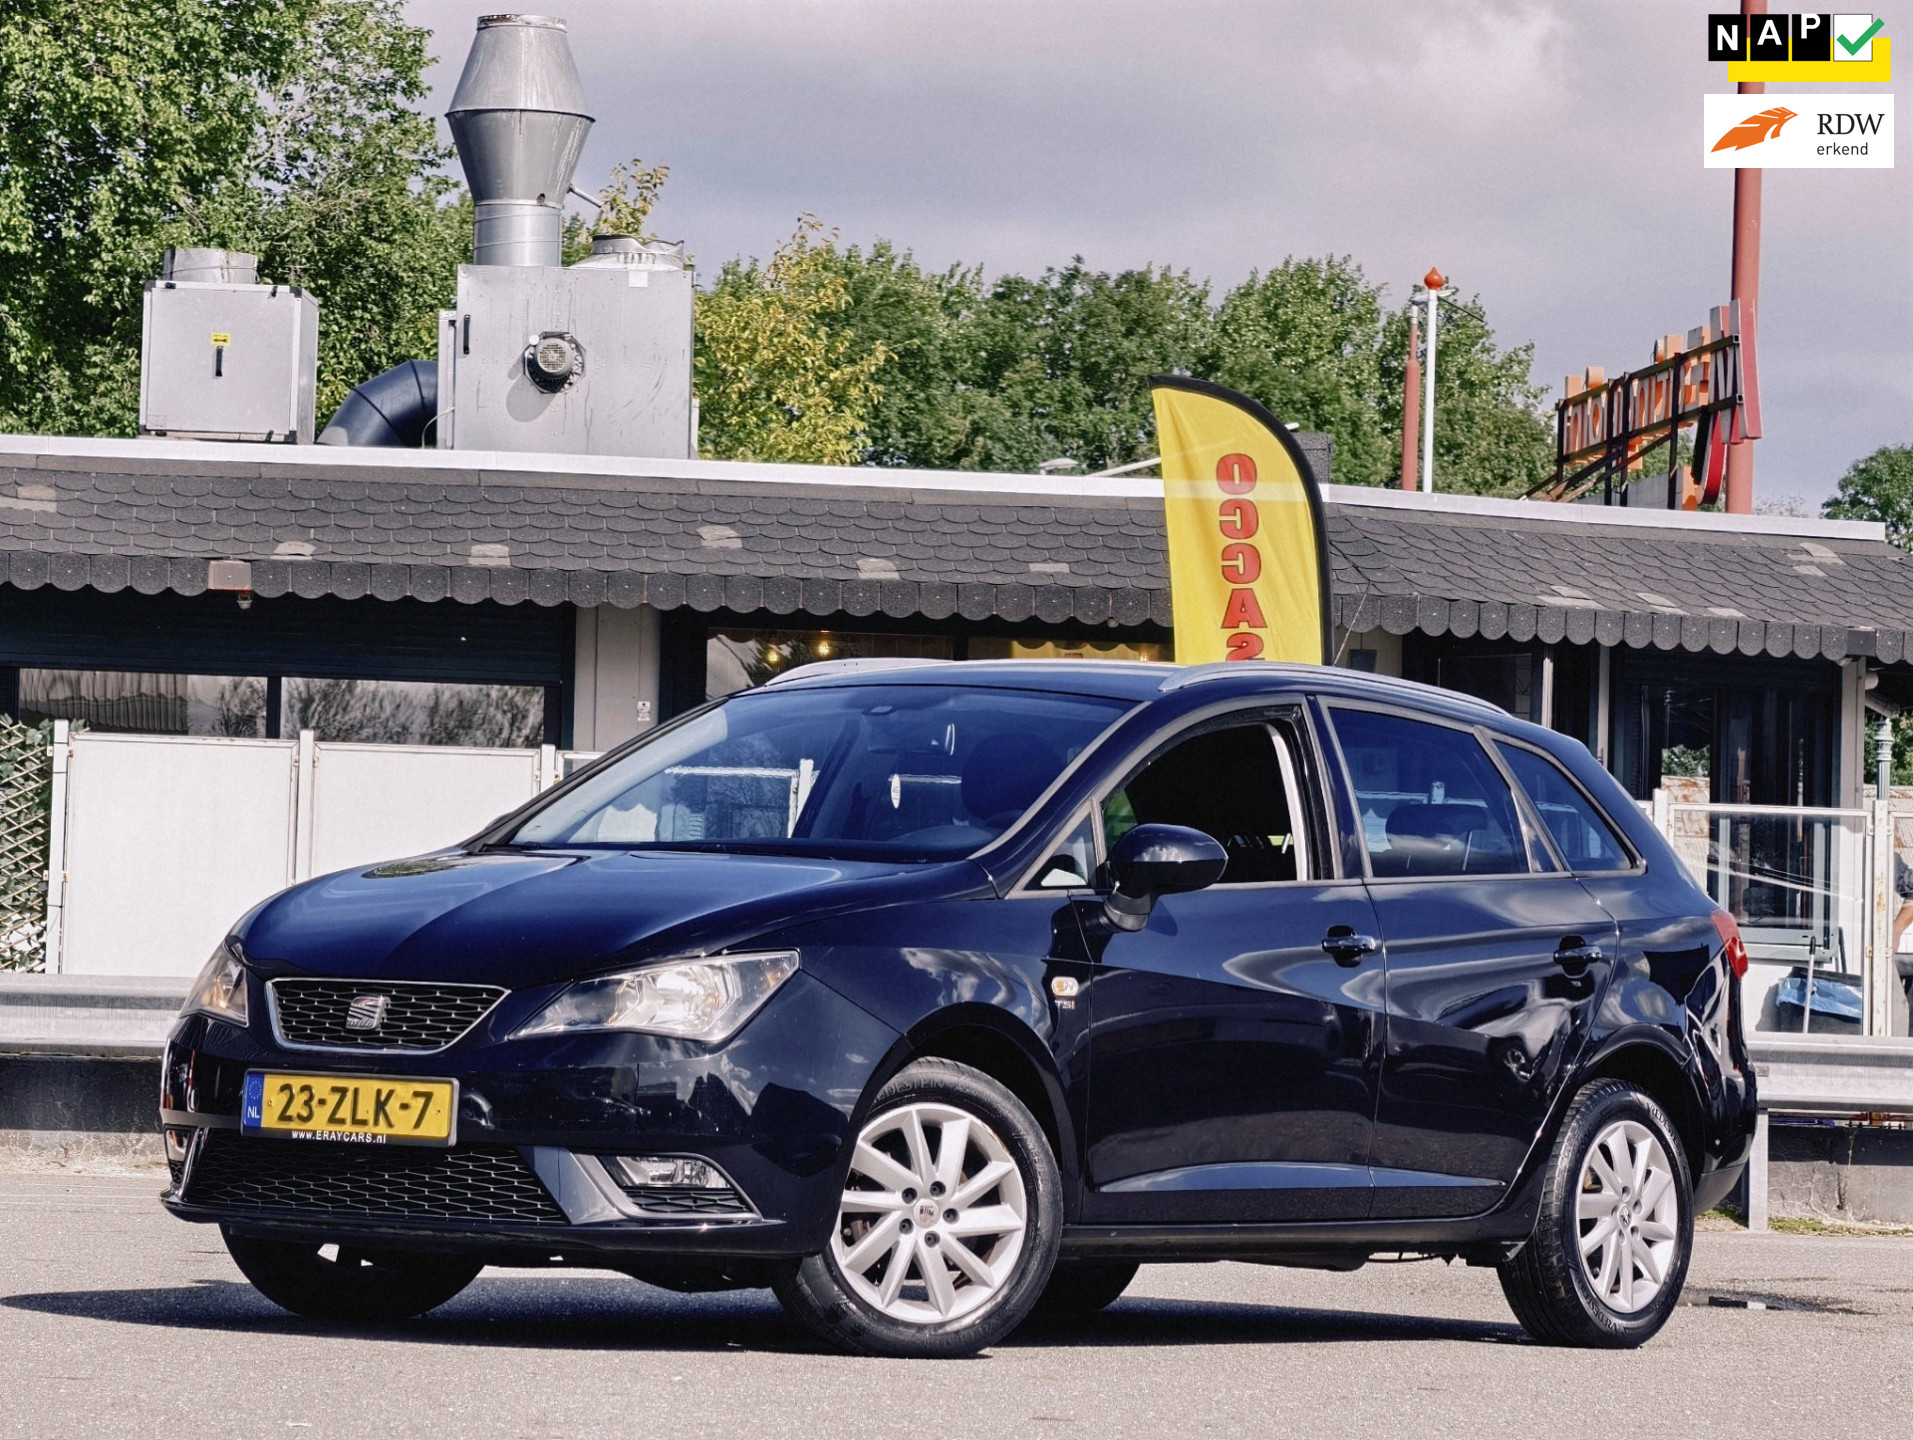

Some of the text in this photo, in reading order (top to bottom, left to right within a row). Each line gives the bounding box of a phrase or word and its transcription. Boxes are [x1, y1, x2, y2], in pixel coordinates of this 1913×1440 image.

[247, 1106, 260, 1119] NL
[277, 1083, 434, 1130] 23-ZLK-7
[291, 1129, 387, 1144] www.ERAYCARS.nl
